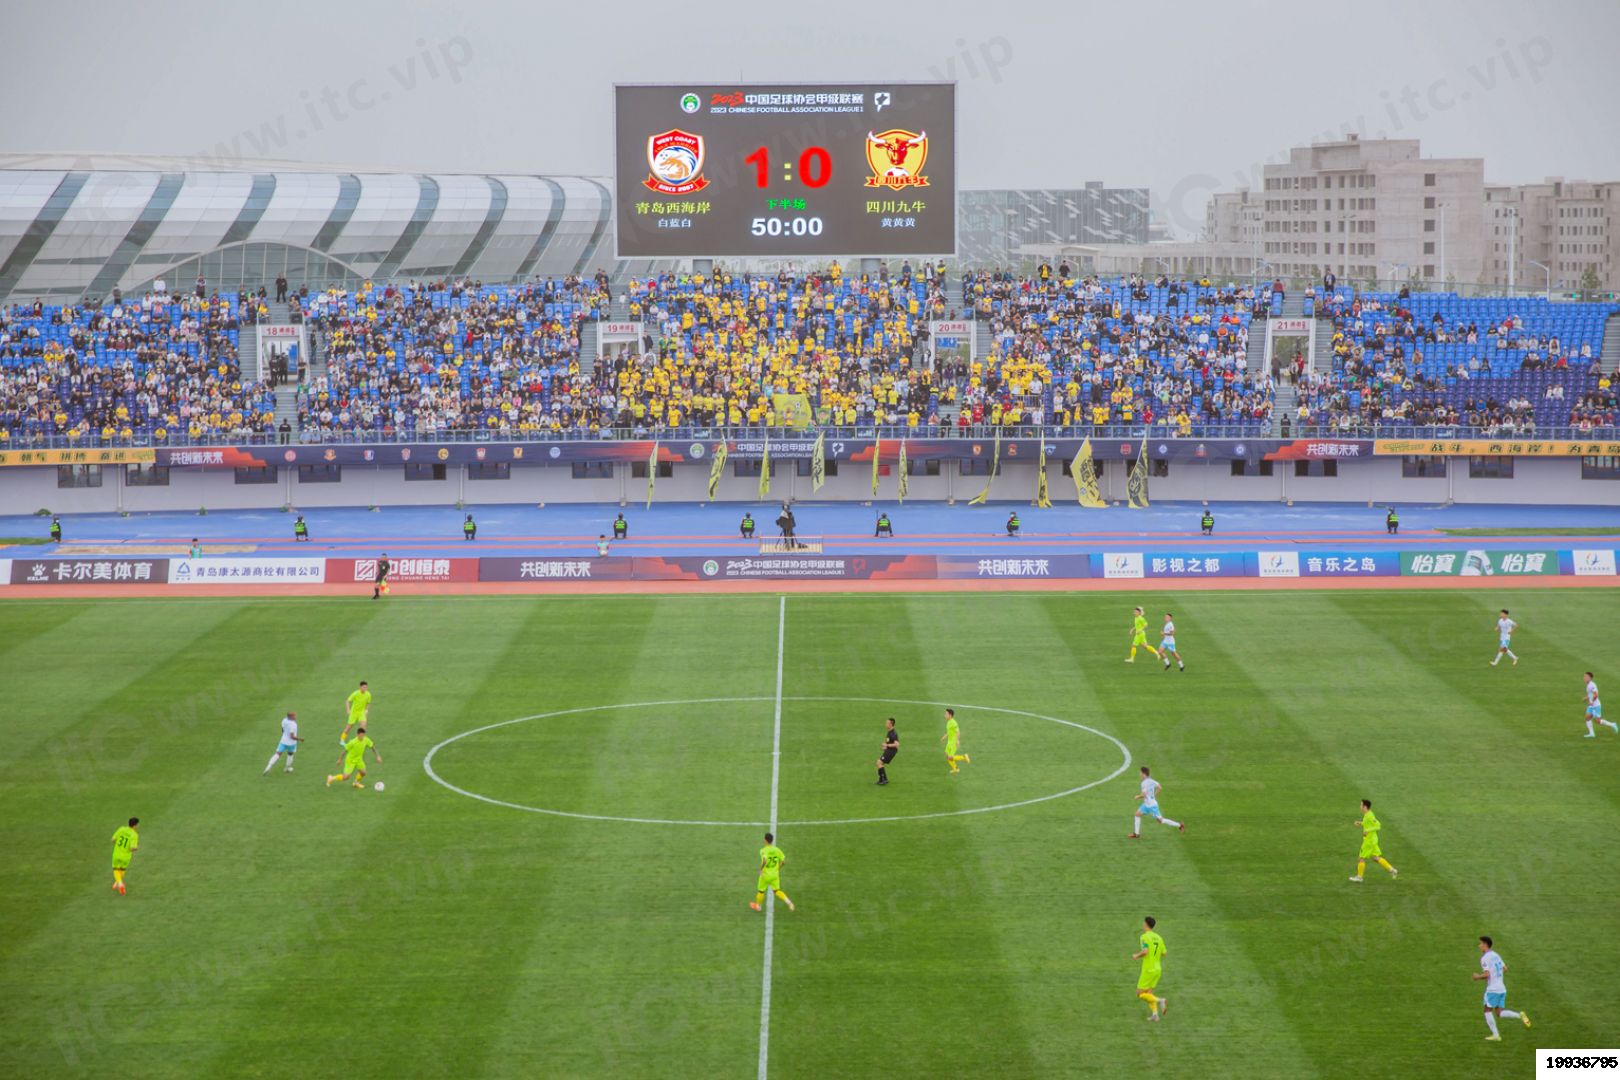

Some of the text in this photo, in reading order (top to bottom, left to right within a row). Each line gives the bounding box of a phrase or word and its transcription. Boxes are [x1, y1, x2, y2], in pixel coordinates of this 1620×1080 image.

[635, 202, 711, 215] 青岛西海岸
[767, 197, 807, 211] 下半场
[866, 200, 926, 214] 四川九牛
[751, 217, 823, 236] 50:00
[881, 217, 916, 228] 黄黄黄
[1307, 443, 1359, 456] 共创新未来
[170, 451, 223, 465] 共创新未来
[53, 562, 153, 581] 卡尔美体育
[520, 561, 592, 578] 共创新未来
[978, 559, 1049, 575] 共创新未来
[1152, 557, 1220, 573] 影视之都
[1307, 557, 1376, 572] 音乐之岛
[117, 835, 129, 849] 31
[766, 856, 778, 868] 25
[1153, 942, 1159, 957] 7
